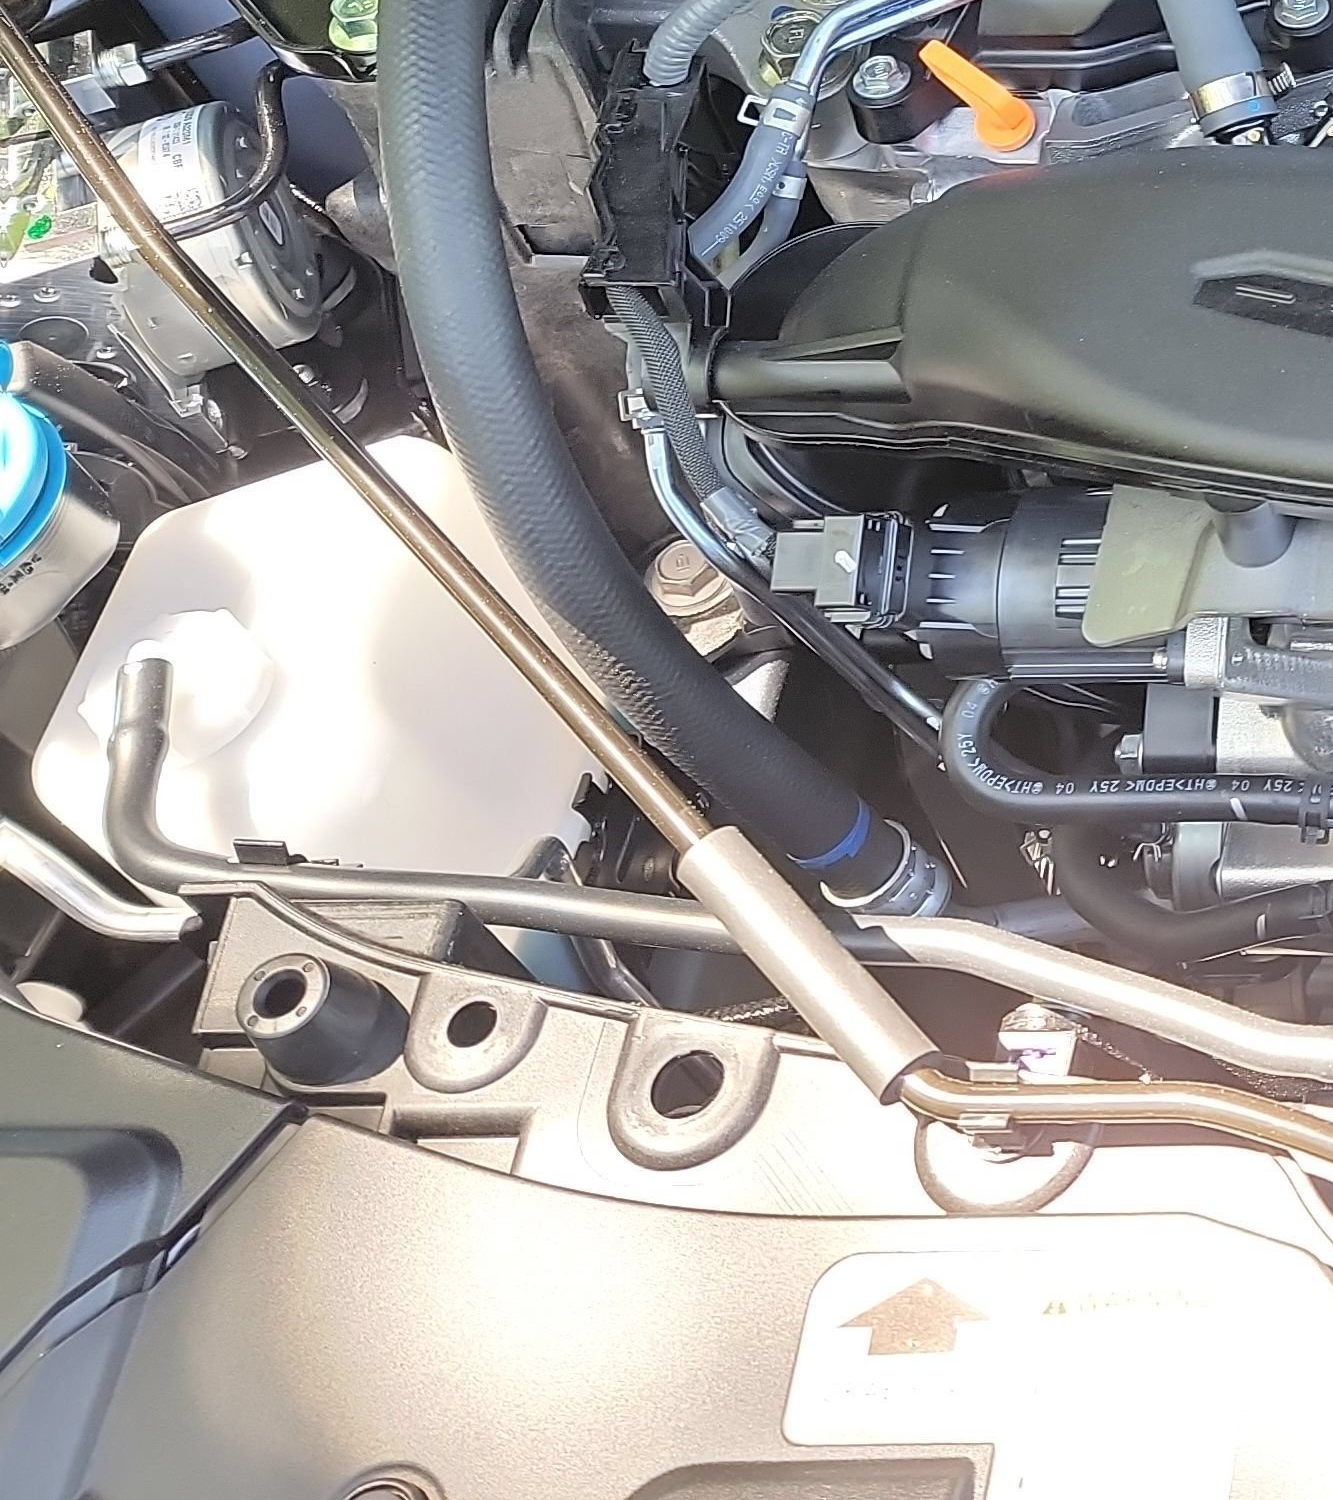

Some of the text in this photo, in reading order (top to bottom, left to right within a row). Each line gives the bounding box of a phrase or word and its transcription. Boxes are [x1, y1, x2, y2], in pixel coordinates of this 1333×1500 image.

[1054, 781, 1075, 796] 04
[1089, 780, 1121, 795] 25Y
[1230, 778, 1251, 794] 04
[1262, 778, 1293, 793] 25Y
